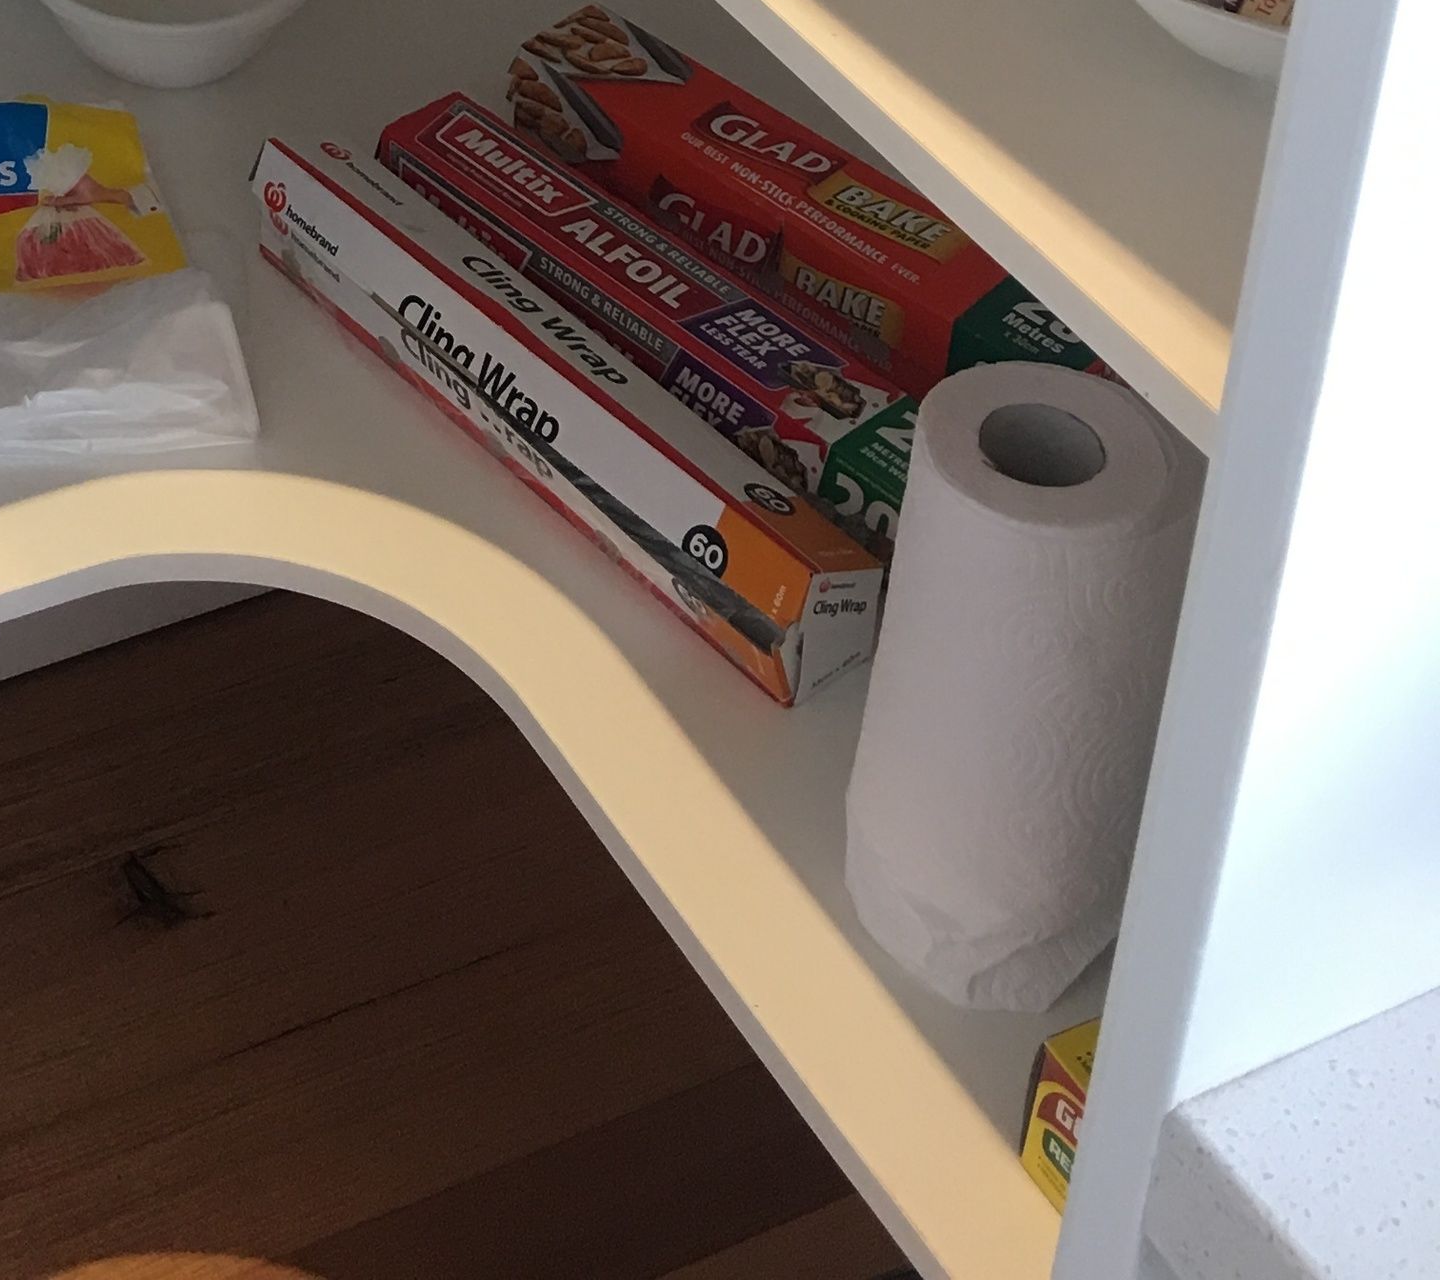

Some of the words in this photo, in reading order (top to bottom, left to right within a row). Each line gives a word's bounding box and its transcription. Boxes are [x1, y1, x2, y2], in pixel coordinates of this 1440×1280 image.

[453, 127, 565, 206] Multix
[708, 113, 835, 174] GLAD
[285, 203, 340, 257] homebrand
[680, 130, 703, 150] OUR
[702, 145, 731, 167] BEST
[730, 160, 795, 209] NON-STICK
[795, 200, 889, 266] PERFORMANCE
[890, 261, 922, 286] EVER.
[832, 184, 953, 242] BAKE
[835, 200, 891, 235] COOKING
[890, 227, 932, 250] PAPER
[559, 218, 692, 311] ALFOIL
[604, 205, 657, 246] STRONG
[656, 238, 667, 254] &
[666, 247, 731, 296] RELIABLE
[462, 255, 544, 314] Cling
[540, 316, 630, 386] Wrap
[539, 255, 591, 301] STRONG
[591, 293, 602, 307] &
[602, 297, 666, 354] RELIABLE
[734, 307, 812, 358] MORE
[1001, 311, 1065, 354] Metres
[698, 321, 734, 348] LESS
[732, 342, 770, 371] TEAR
[713, 313, 780, 359] FLEX
[398, 293, 476, 371] Cling
[478, 351, 561, 445] Wrap
[674, 365, 747, 427] MORE
[750, 486, 794, 515] 60
[688, 531, 725, 571] 60
[812, 599, 840, 618] Cling
[839, 598, 868, 616] Wrap
